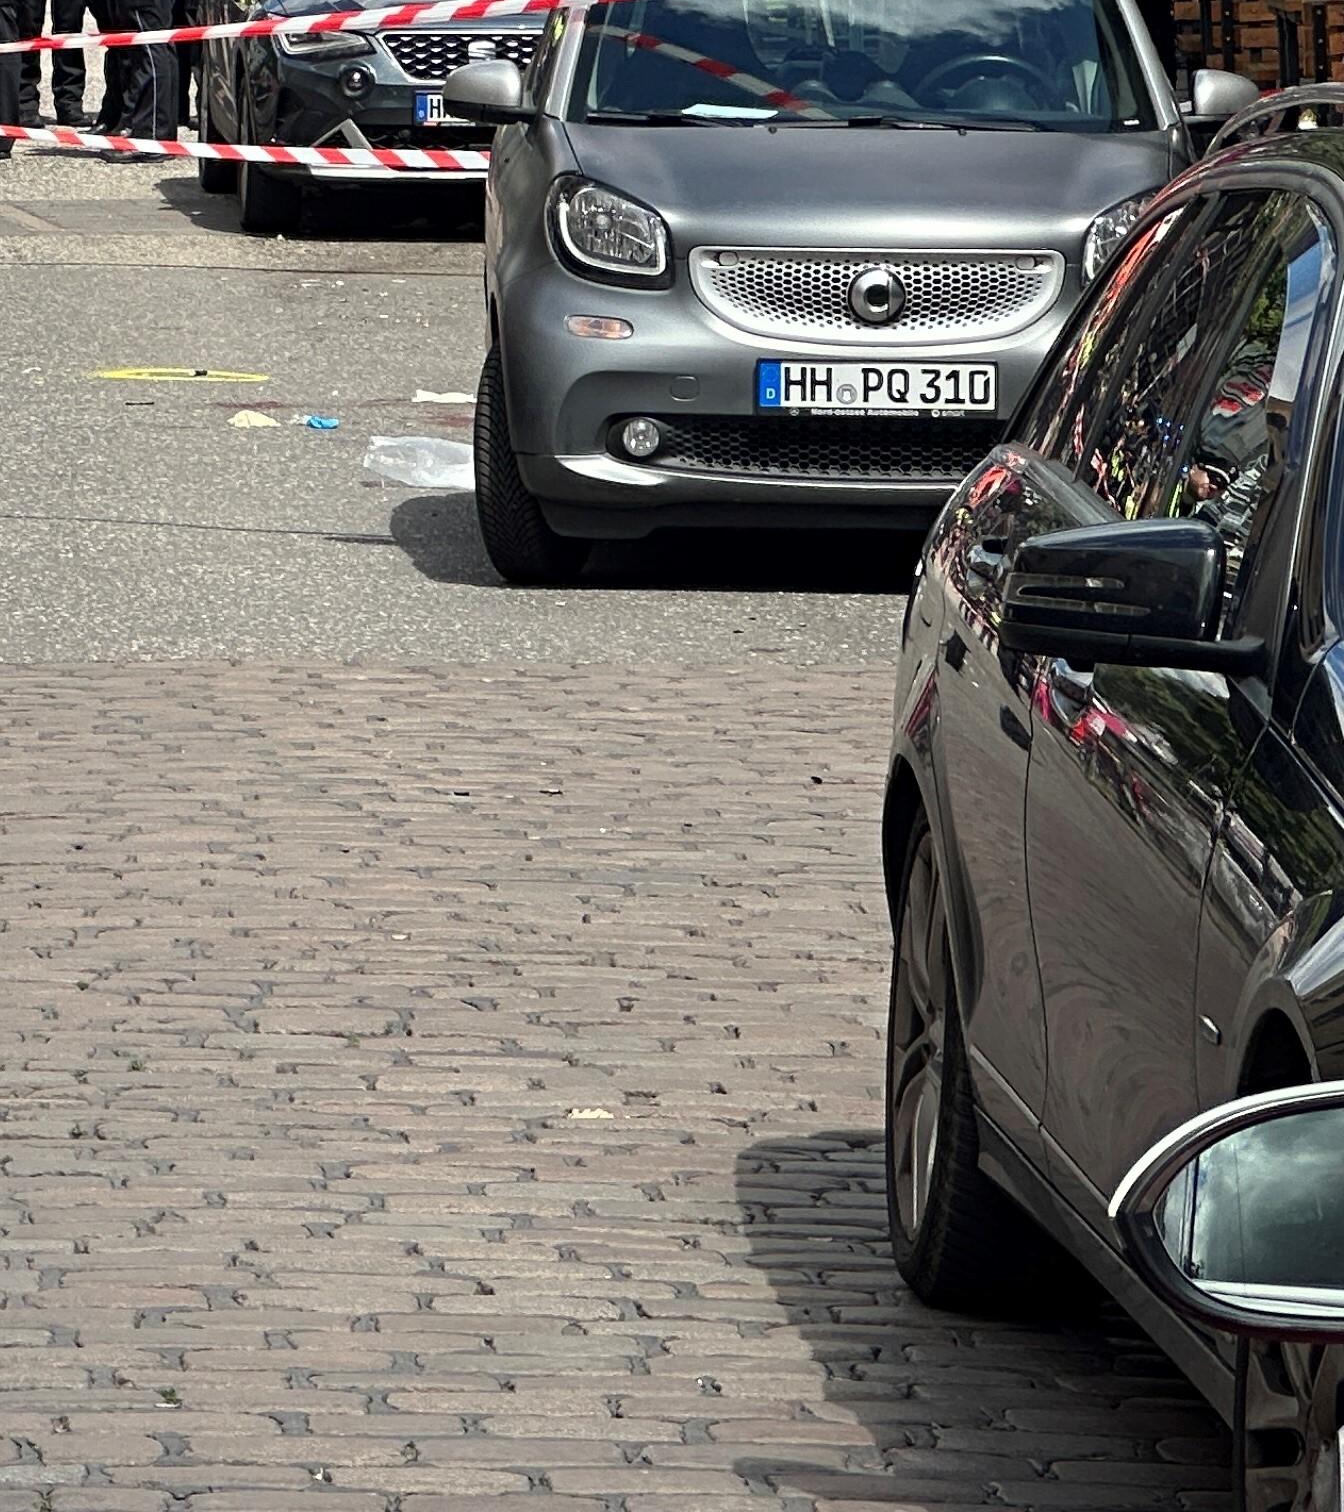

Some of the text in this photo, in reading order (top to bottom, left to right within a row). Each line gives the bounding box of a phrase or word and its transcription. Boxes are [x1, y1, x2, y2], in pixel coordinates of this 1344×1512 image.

[766, 366, 991, 405] D HH PQ 310
